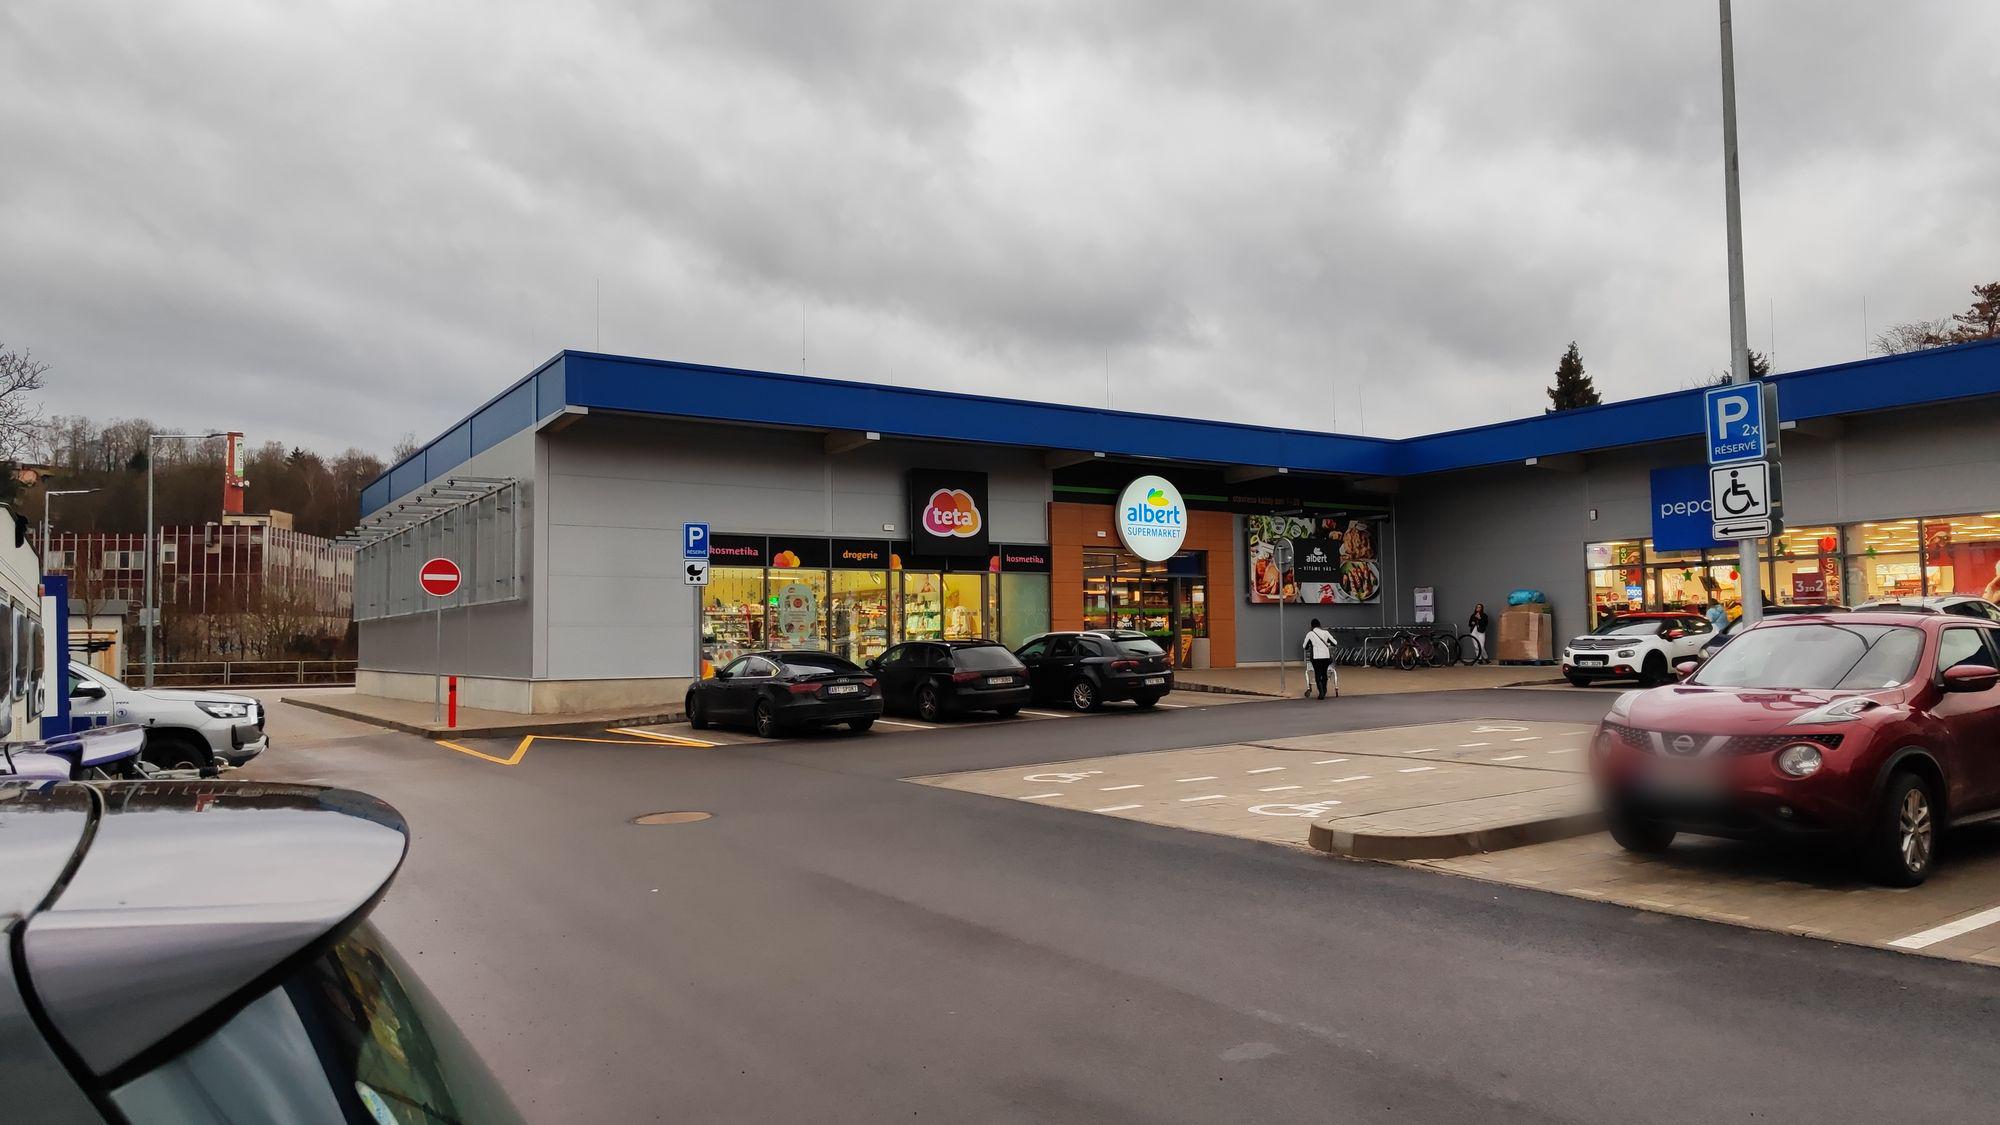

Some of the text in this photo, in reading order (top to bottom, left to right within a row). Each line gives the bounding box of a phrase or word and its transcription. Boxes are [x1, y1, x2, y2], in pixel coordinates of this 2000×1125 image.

[1717, 395, 1749, 440] P
[1742, 423, 1760, 436] 2x
[1714, 439, 1757, 455] RÉSERVÉ
[933, 507, 972, 526] teta
[1127, 503, 1180, 524] albert
[1661, 500, 1712, 519] pepc
[689, 527, 704, 547] P
[1127, 526, 1180, 539] SUPERMARKET
[709, 545, 759, 556] kosmetika
[842, 550, 879, 561] drogerie
[1006, 554, 1044, 564] kosmetika
[1305, 554, 1328, 563] albert
